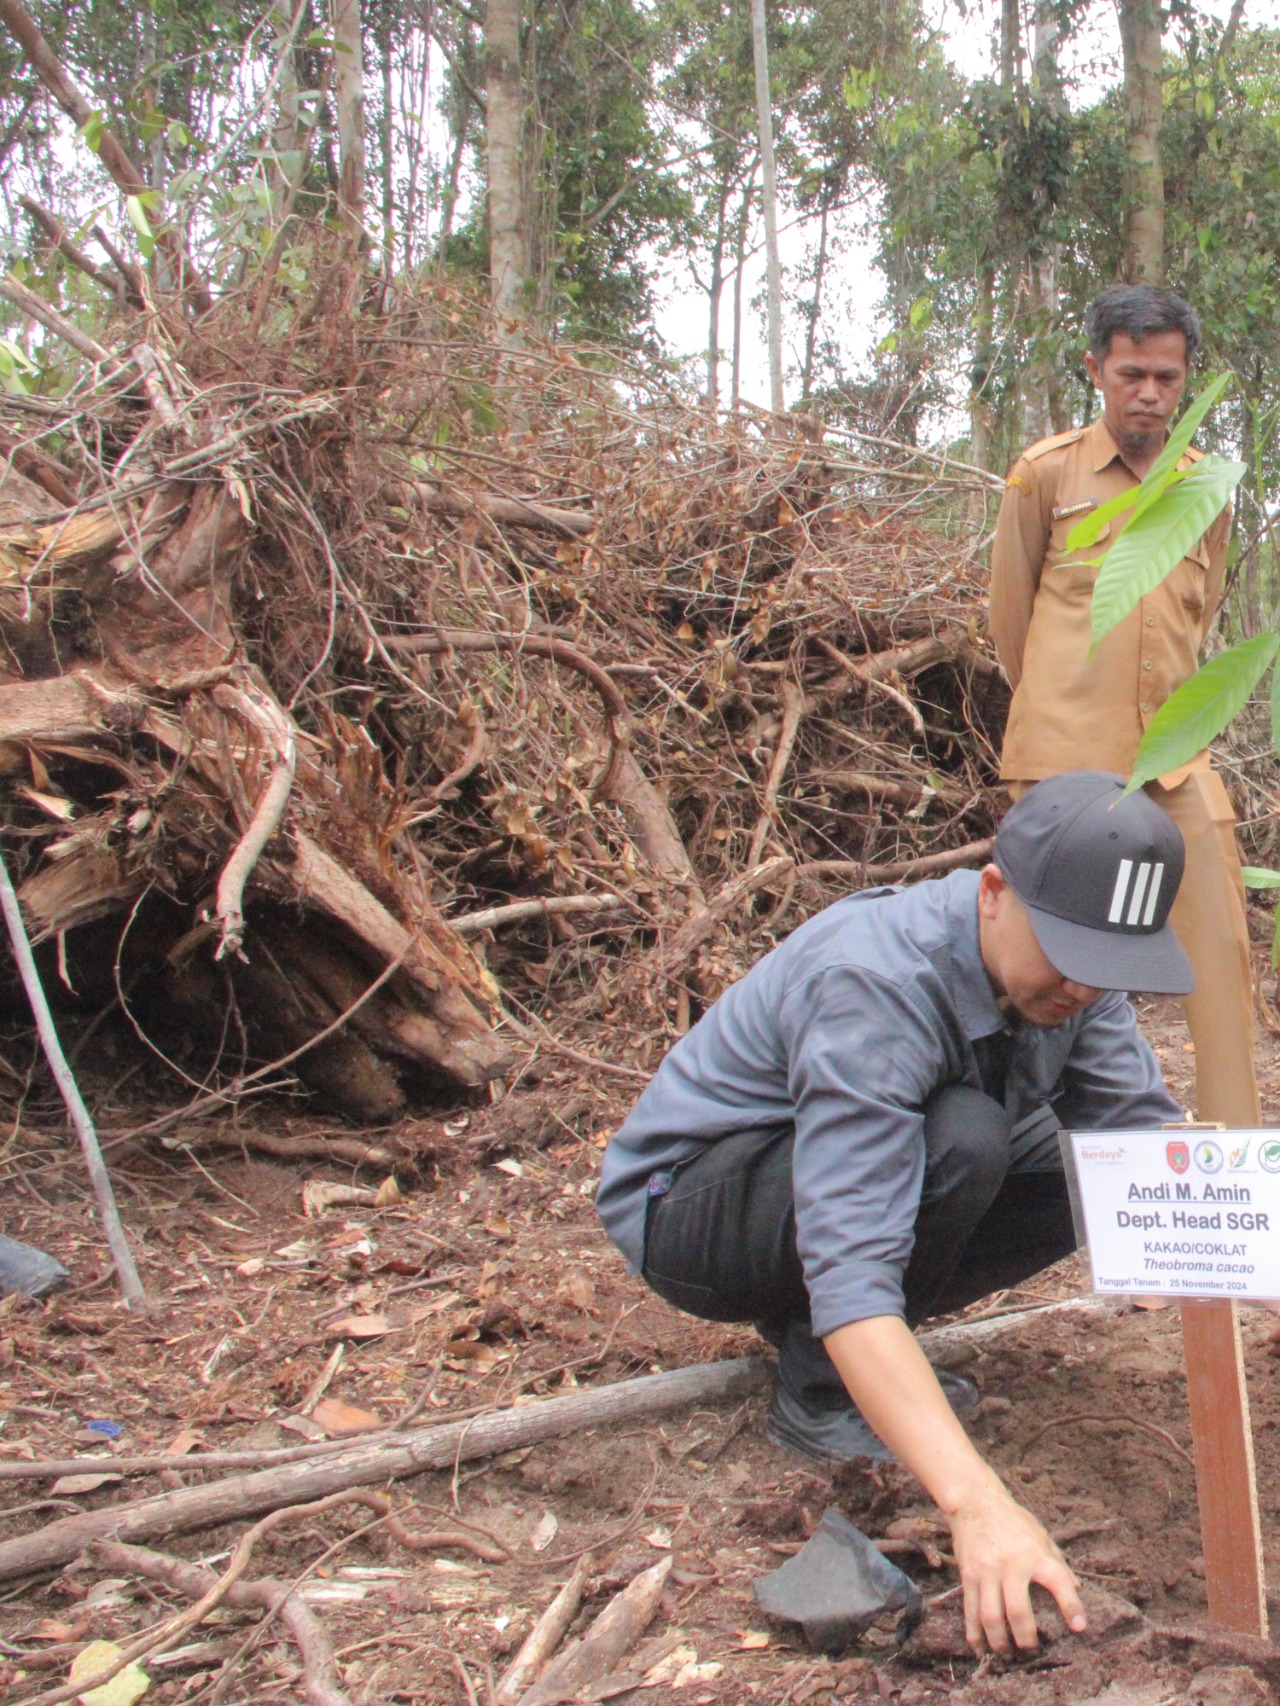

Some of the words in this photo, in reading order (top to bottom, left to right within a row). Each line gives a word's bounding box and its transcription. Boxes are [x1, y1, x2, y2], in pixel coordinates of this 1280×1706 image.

[1081, 1149, 1122, 1160] Berdaya
[1128, 1183, 1170, 1200] Andi
[1176, 1183, 1197, 1200] M.
[1203, 1184, 1251, 1201] Amin
[1117, 1211, 1167, 1231] Dept.
[1173, 1212, 1221, 1229] Head
[1227, 1213, 1269, 1231] SGR
[1144, 1242, 1247, 1256] KAKAO/COKLAT
[1144, 1259, 1213, 1272] Theobroma
[1217, 1263, 1255, 1274] cacao
[1098, 1277, 1131, 1288] Tanggal
[1134, 1278, 1161, 1287] Tanam
[1170, 1279, 1180, 1287] 25
[1182, 1280, 1224, 1289] November
[1227, 1281, 1247, 1290] 2024
